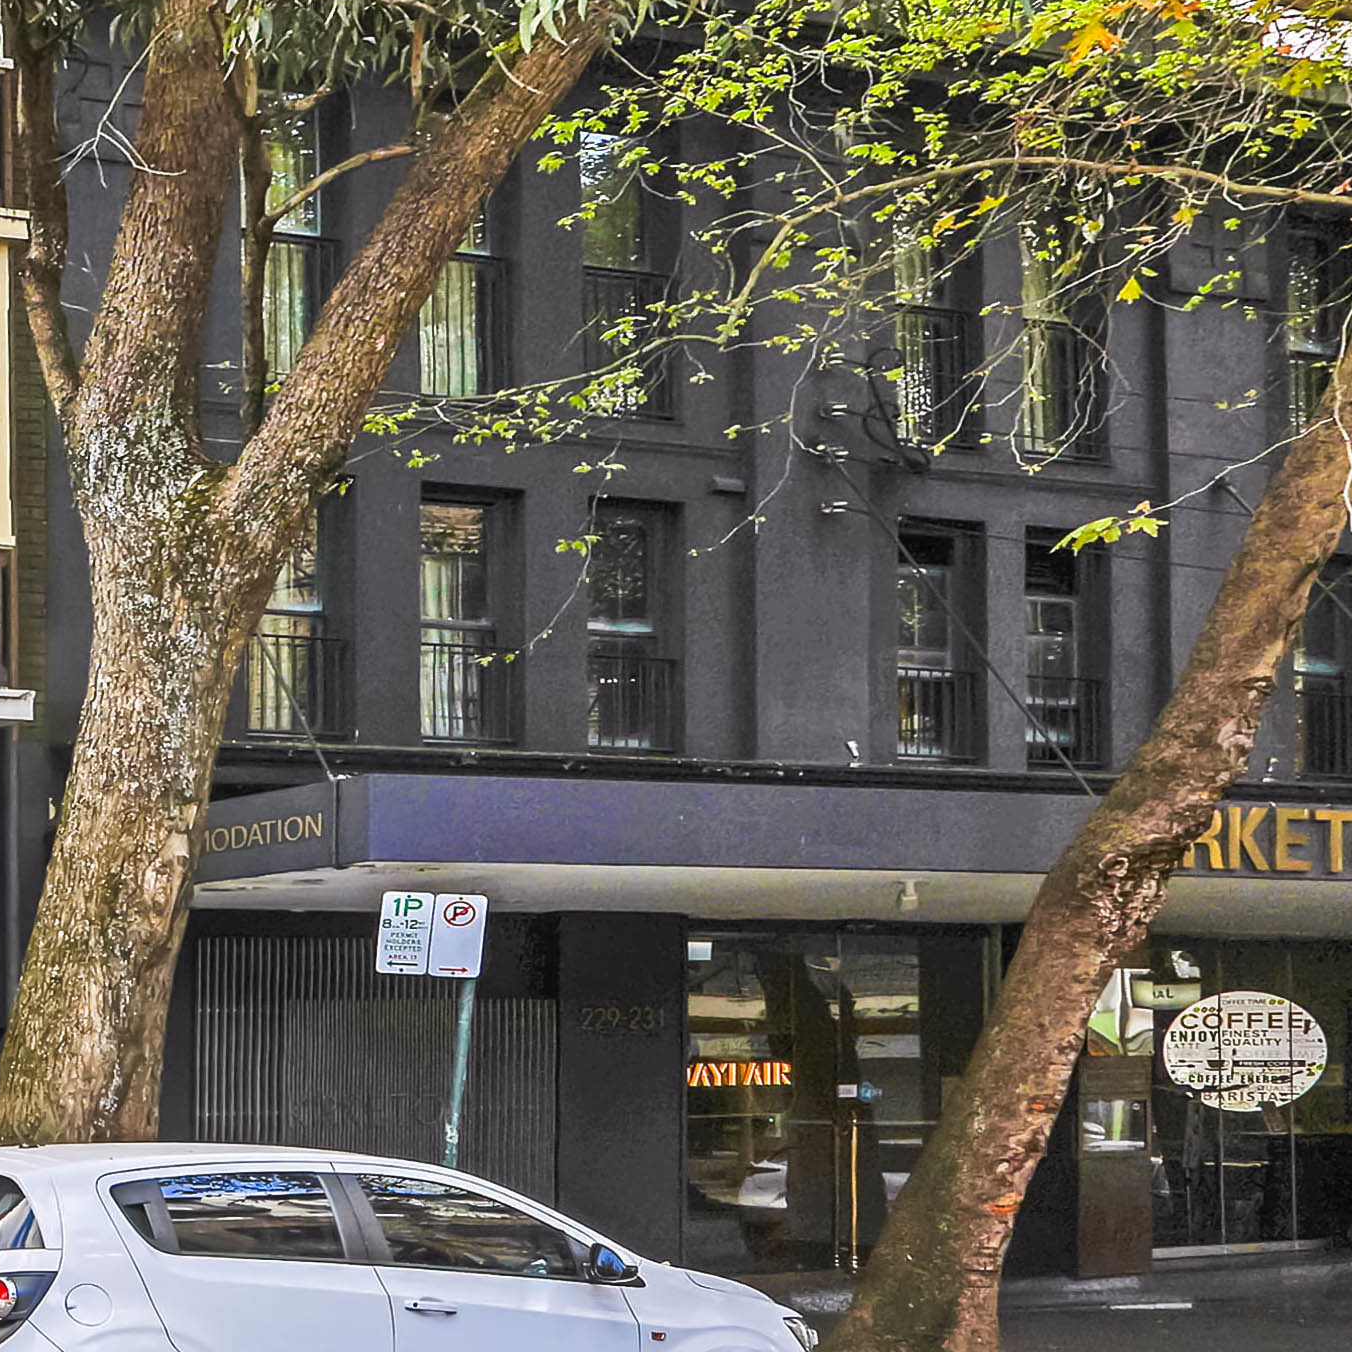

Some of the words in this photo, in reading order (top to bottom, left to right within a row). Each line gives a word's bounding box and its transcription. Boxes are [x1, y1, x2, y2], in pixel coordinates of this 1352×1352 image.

[394, 898, 423, 916] 1P
[1180, 1012, 1303, 1030] COFFEE
[1170, 1031, 1218, 1042] ENJOY
[1222, 1030, 1269, 1038] FINEST
[1222, 1038, 1282, 1047] QUALITY
[1203, 1092, 1278, 1102] BARISTA
